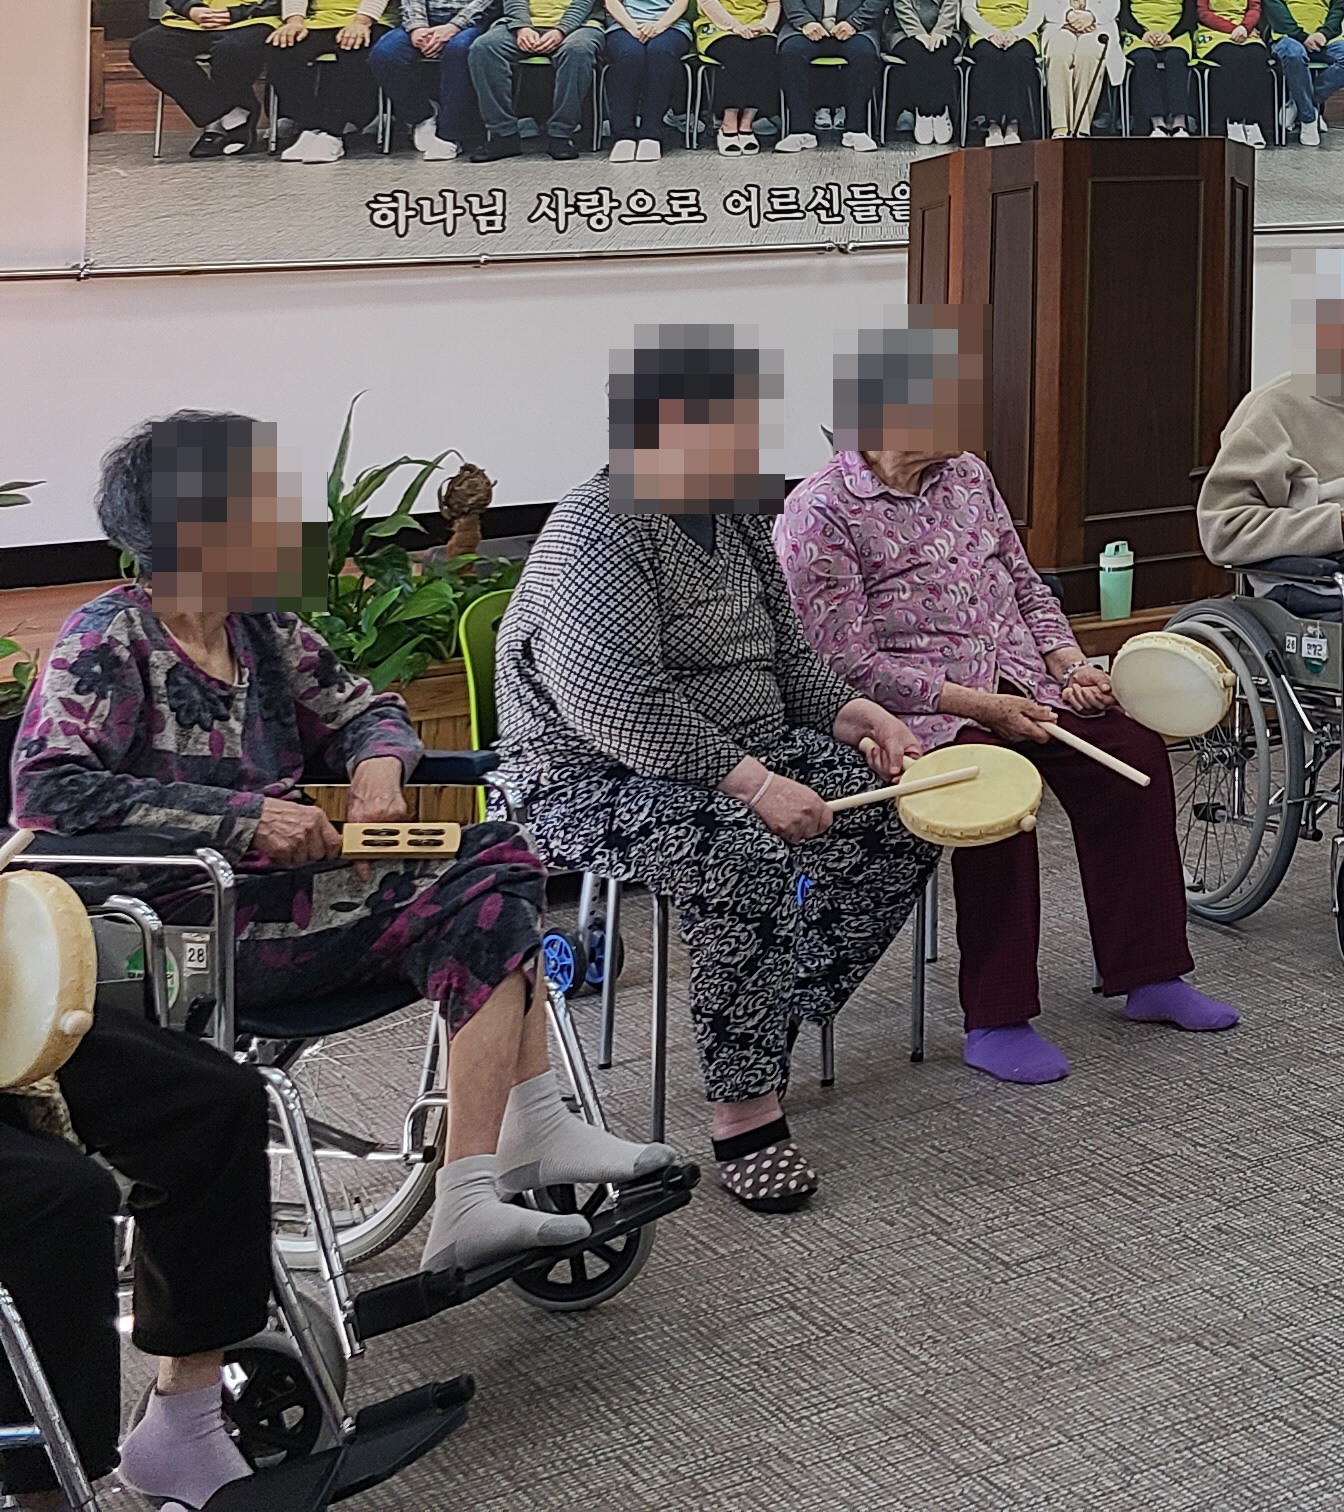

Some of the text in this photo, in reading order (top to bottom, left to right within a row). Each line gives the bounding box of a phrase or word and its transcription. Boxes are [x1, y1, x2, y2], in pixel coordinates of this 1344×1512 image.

[366, 188, 507, 238] 하나님
[527, 186, 708, 234] 사랑으로
[187, 947, 205, 963] 28
